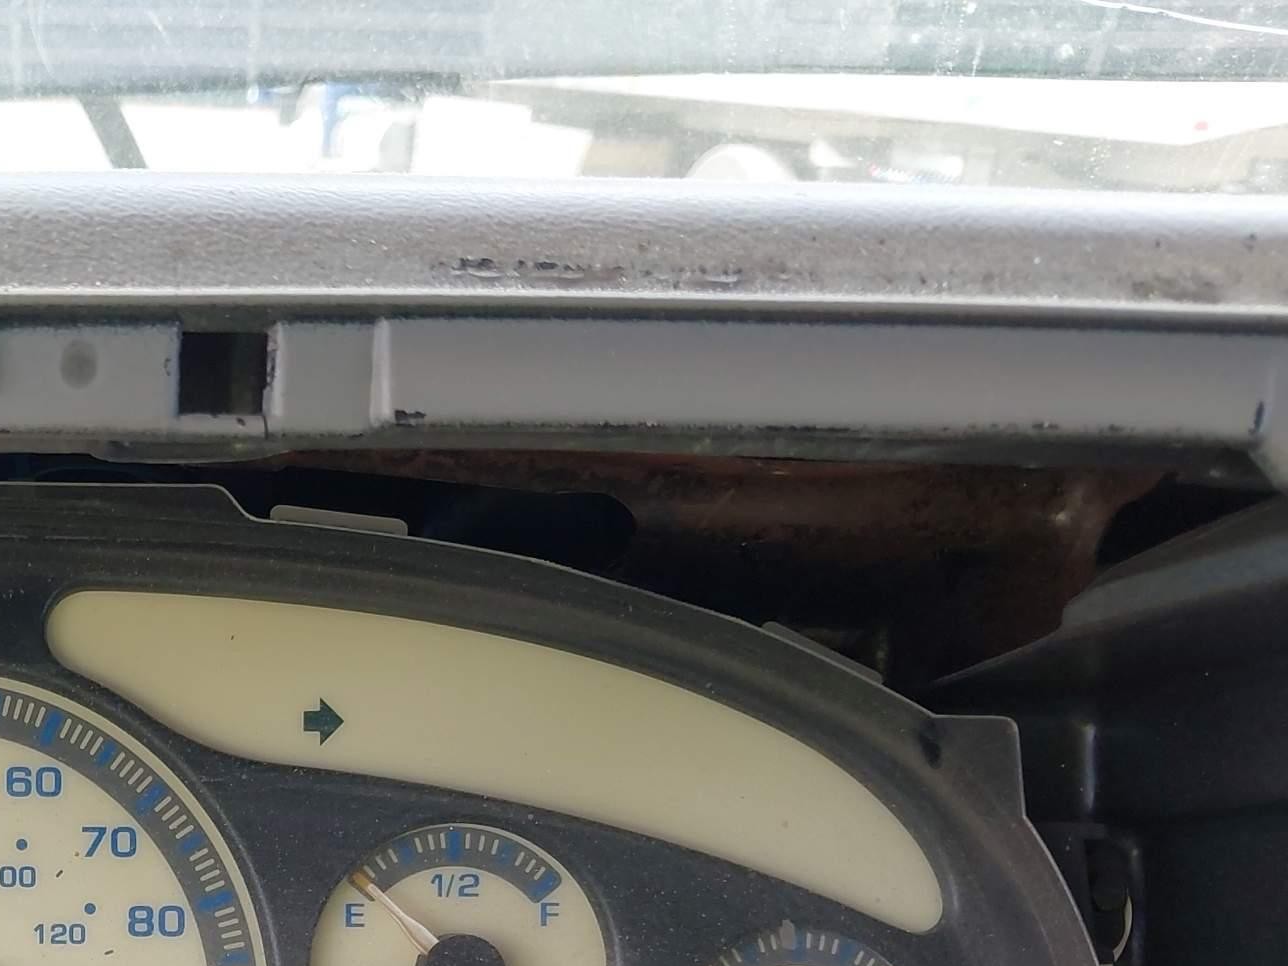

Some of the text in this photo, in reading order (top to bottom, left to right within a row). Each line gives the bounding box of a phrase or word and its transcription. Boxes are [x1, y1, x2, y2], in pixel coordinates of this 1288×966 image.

[7, 767, 61, 797] 60
[82, 827, 136, 857] 70
[431, 874, 479, 897] 1/2
[128, 906, 185, 937] 80
[345, 904, 364, 927] E
[541, 902, 559, 926] F
[34, 924, 85, 944] 120
